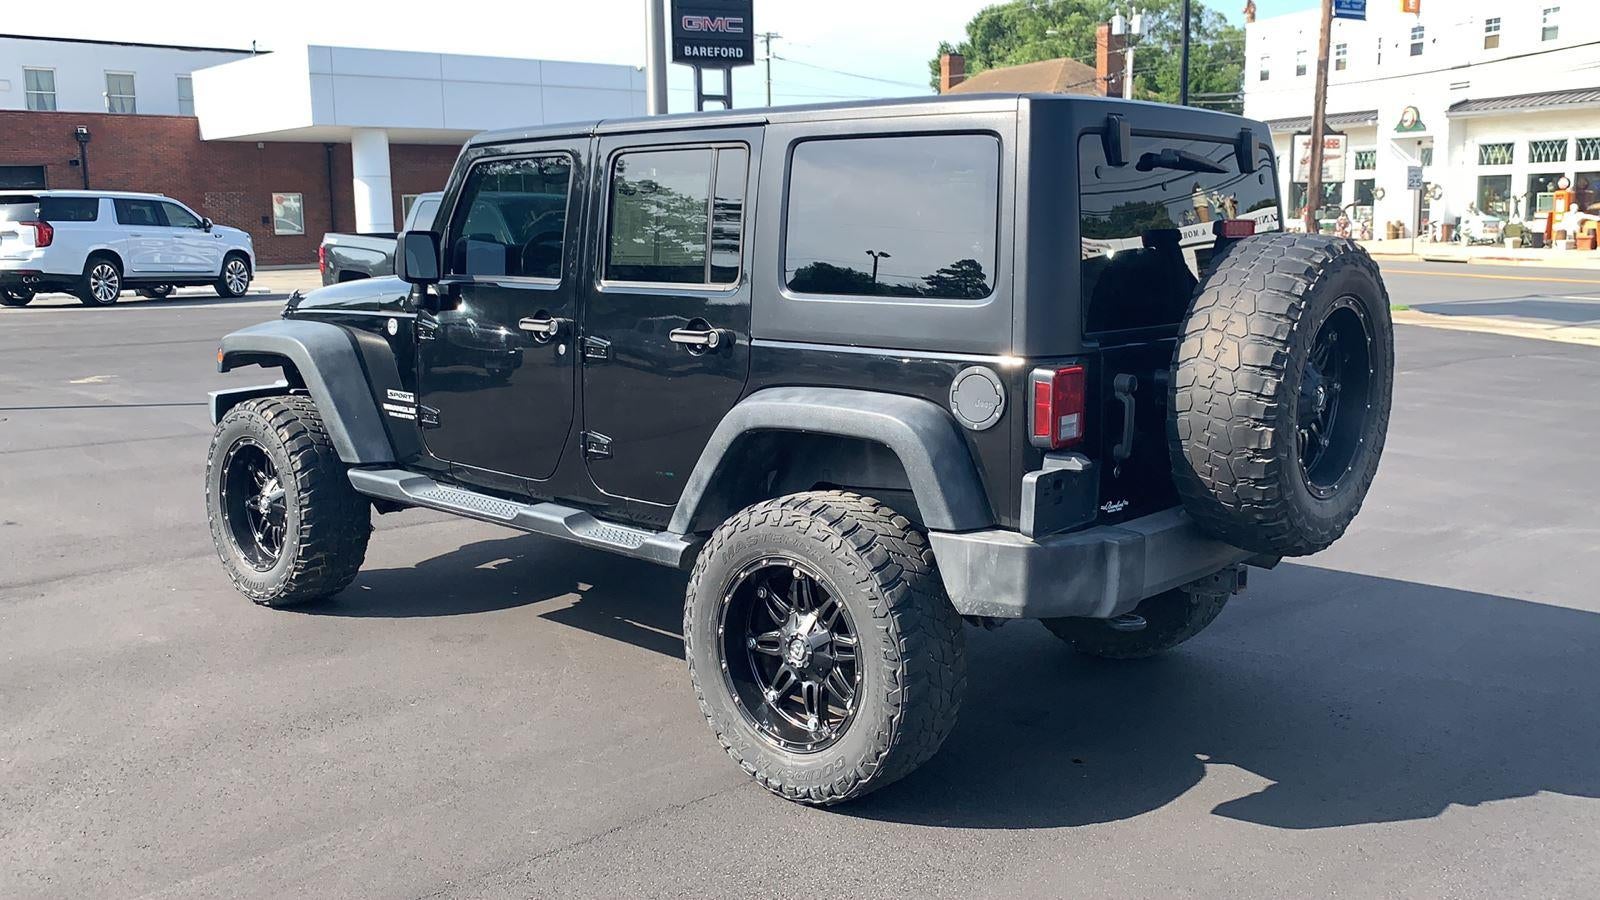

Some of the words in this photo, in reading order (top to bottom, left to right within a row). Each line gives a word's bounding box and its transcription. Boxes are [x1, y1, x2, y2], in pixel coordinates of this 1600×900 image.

[682, 15, 744, 33] GMC
[684, 46, 744, 58] BAREFORD
[1408, 178, 1422, 187] 25
[389, 391, 413, 399] SPORT
[974, 399, 994, 410] Jeep
